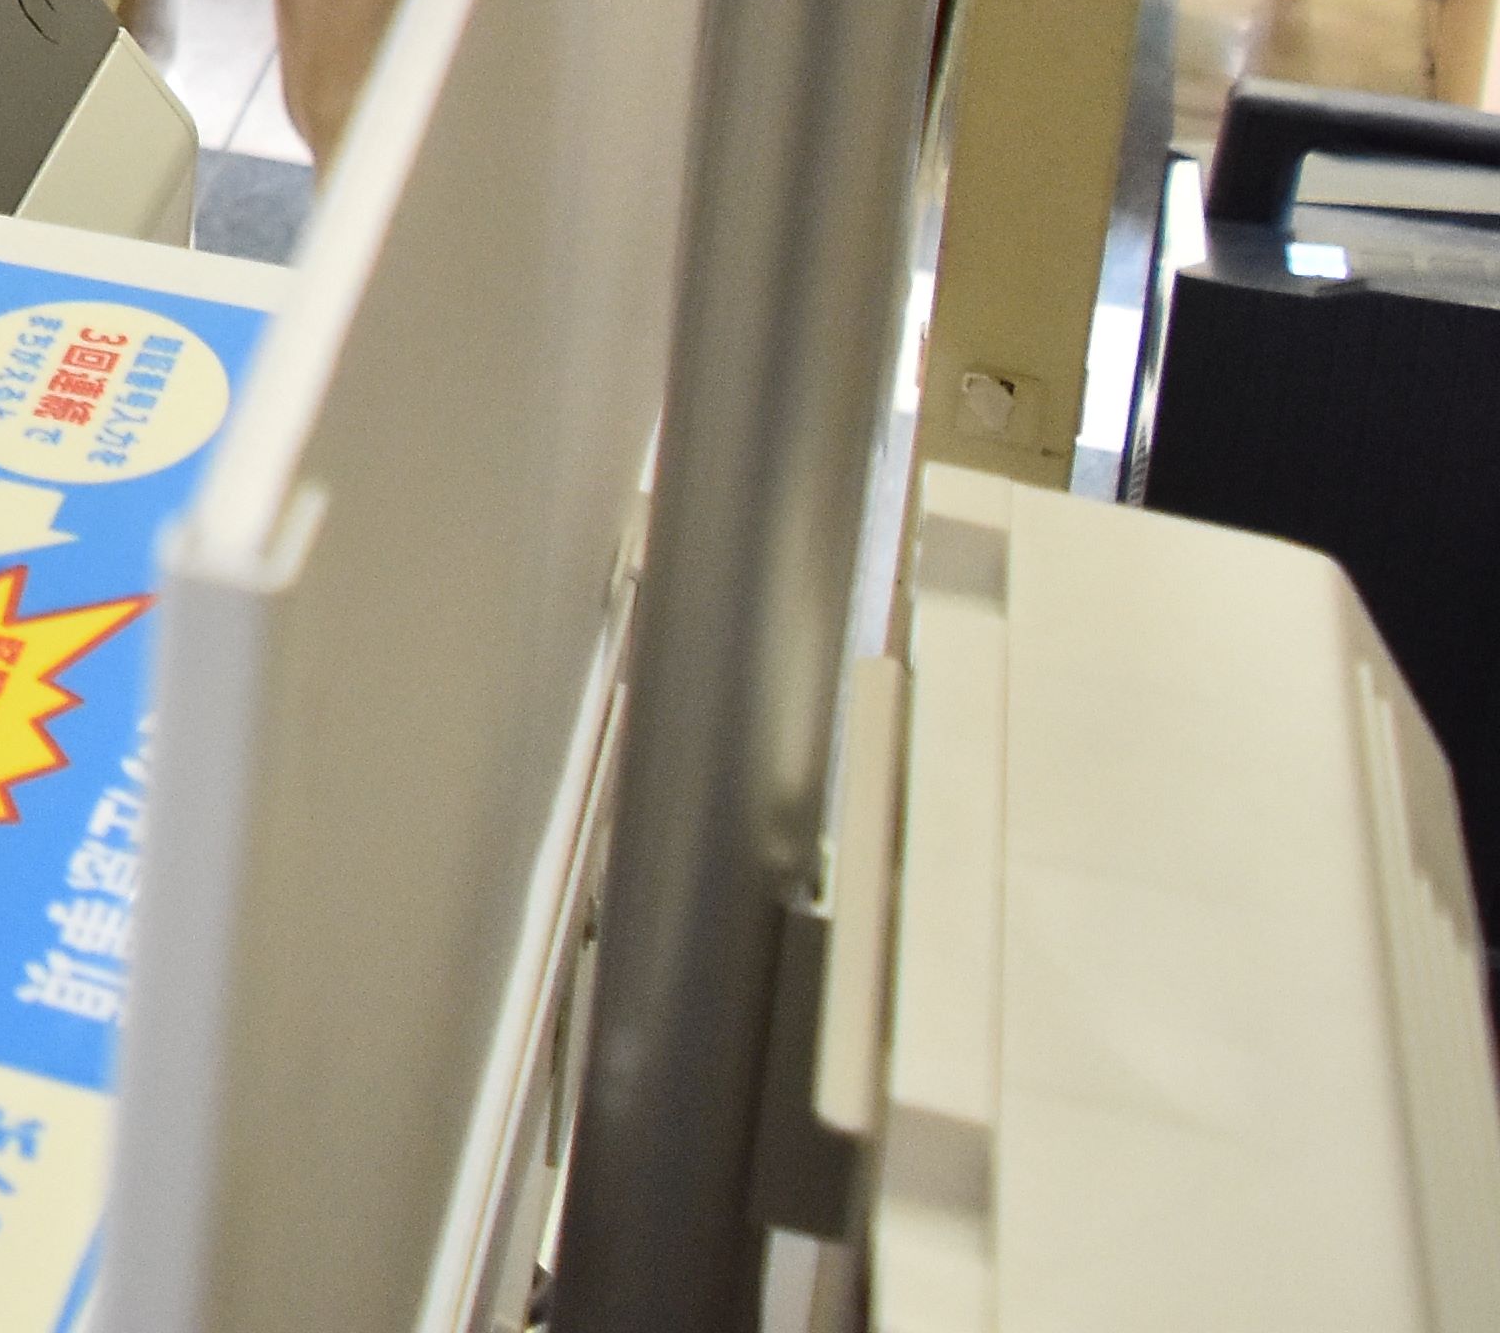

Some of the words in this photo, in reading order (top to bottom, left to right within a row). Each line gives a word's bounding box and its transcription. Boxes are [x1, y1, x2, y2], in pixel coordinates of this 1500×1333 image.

[84, 332, 184, 469] 暗証番号入力を
